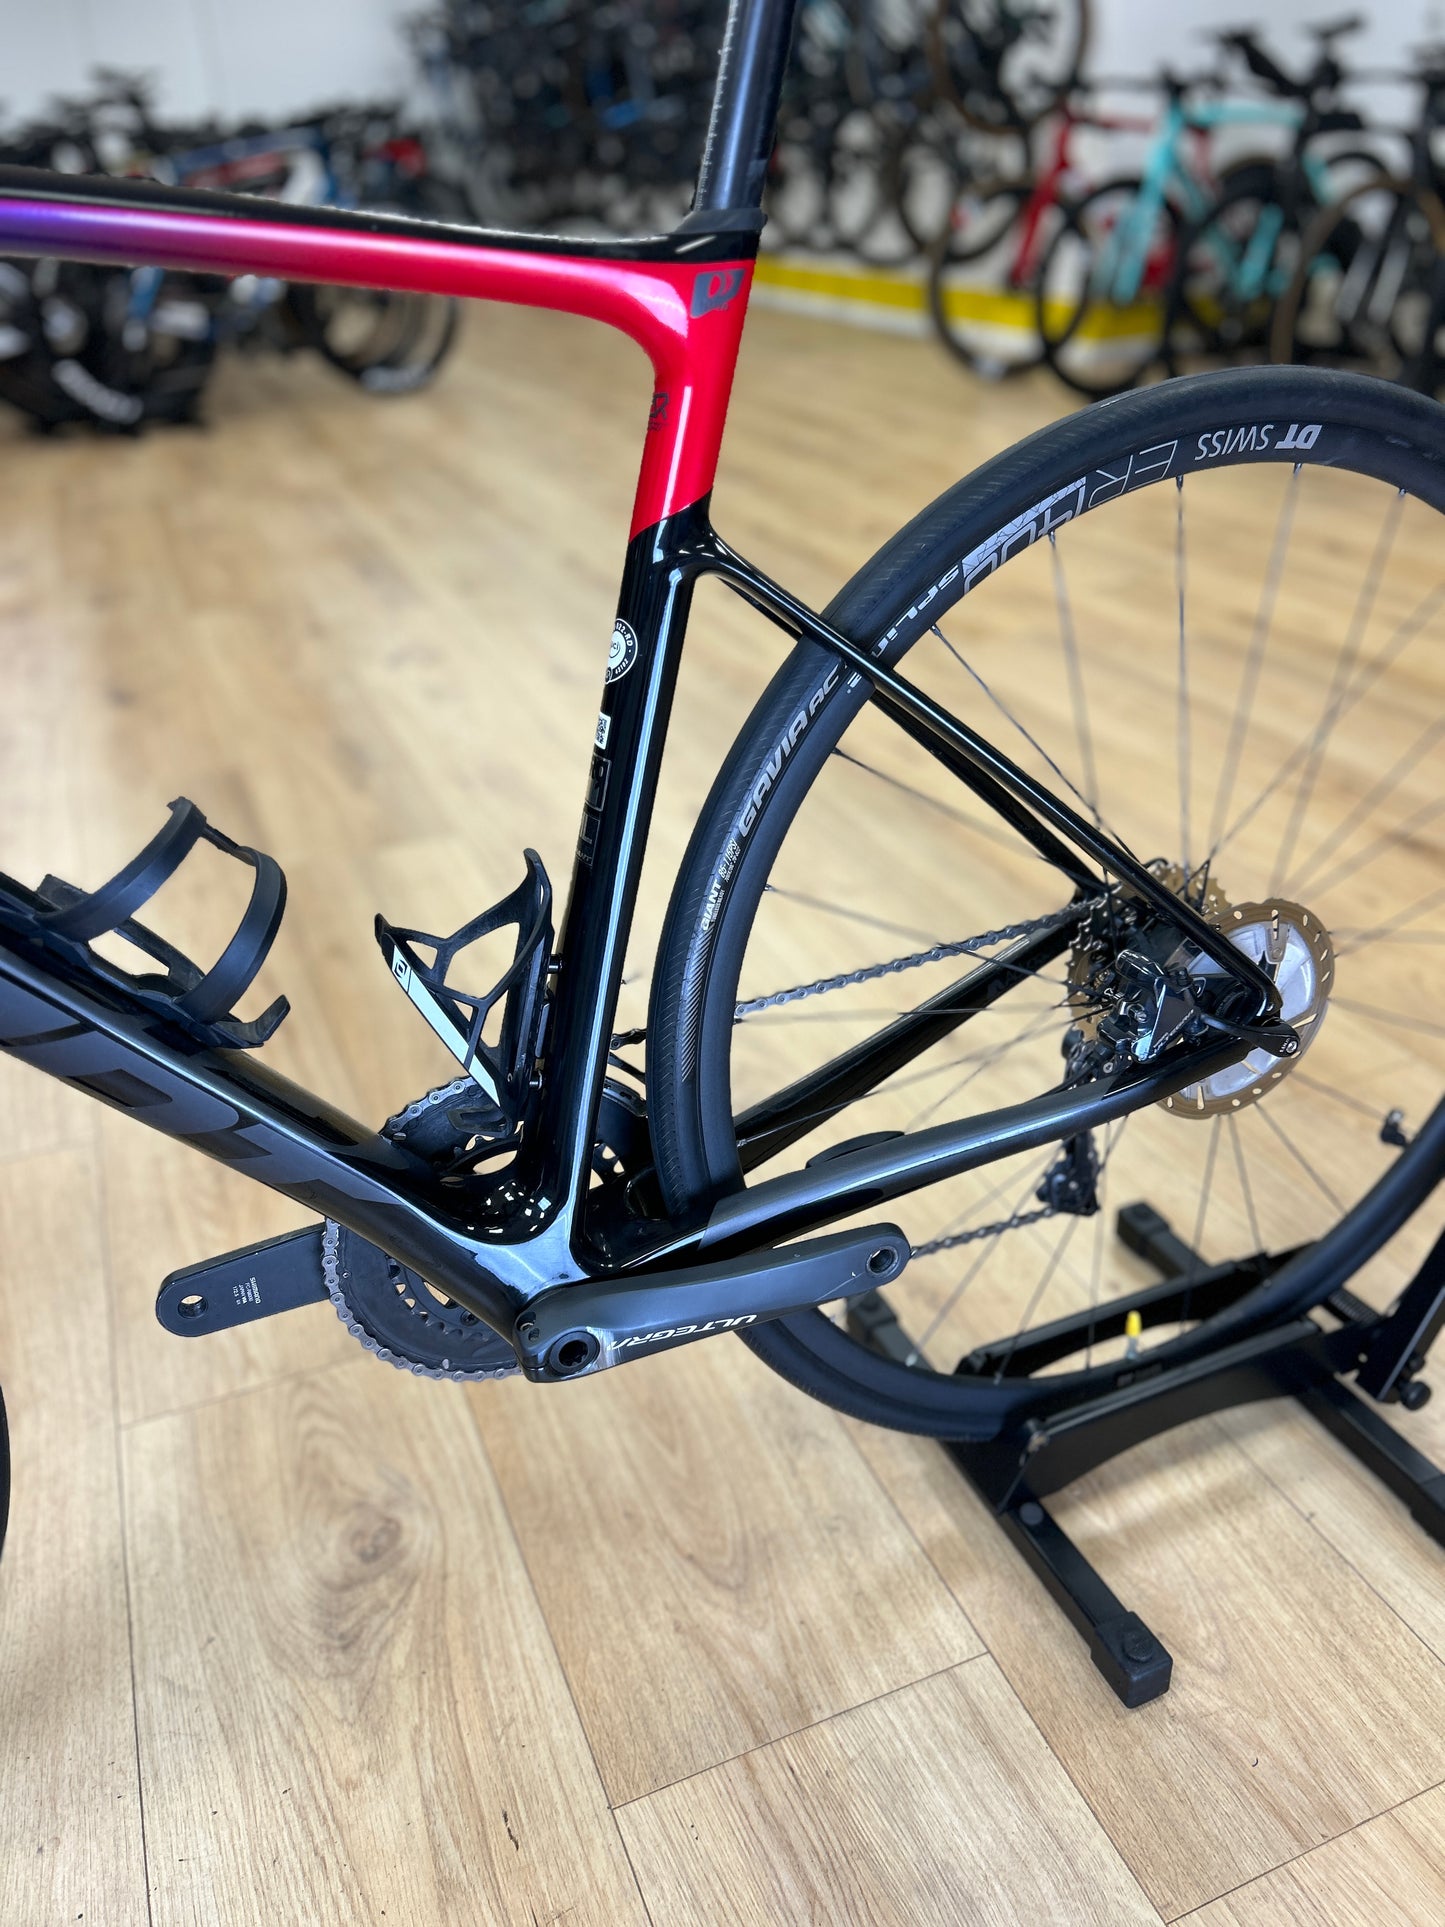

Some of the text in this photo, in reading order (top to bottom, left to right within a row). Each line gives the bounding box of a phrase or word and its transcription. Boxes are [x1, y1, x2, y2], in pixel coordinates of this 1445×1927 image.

[1194, 424, 1275, 461] SWISS
[1274, 424, 1323, 450] DT
[738, 664, 840, 838] GAVIA AC
[700, 878, 722, 931] GIANT
[606, 1313, 758, 1351] ULTEGRA
